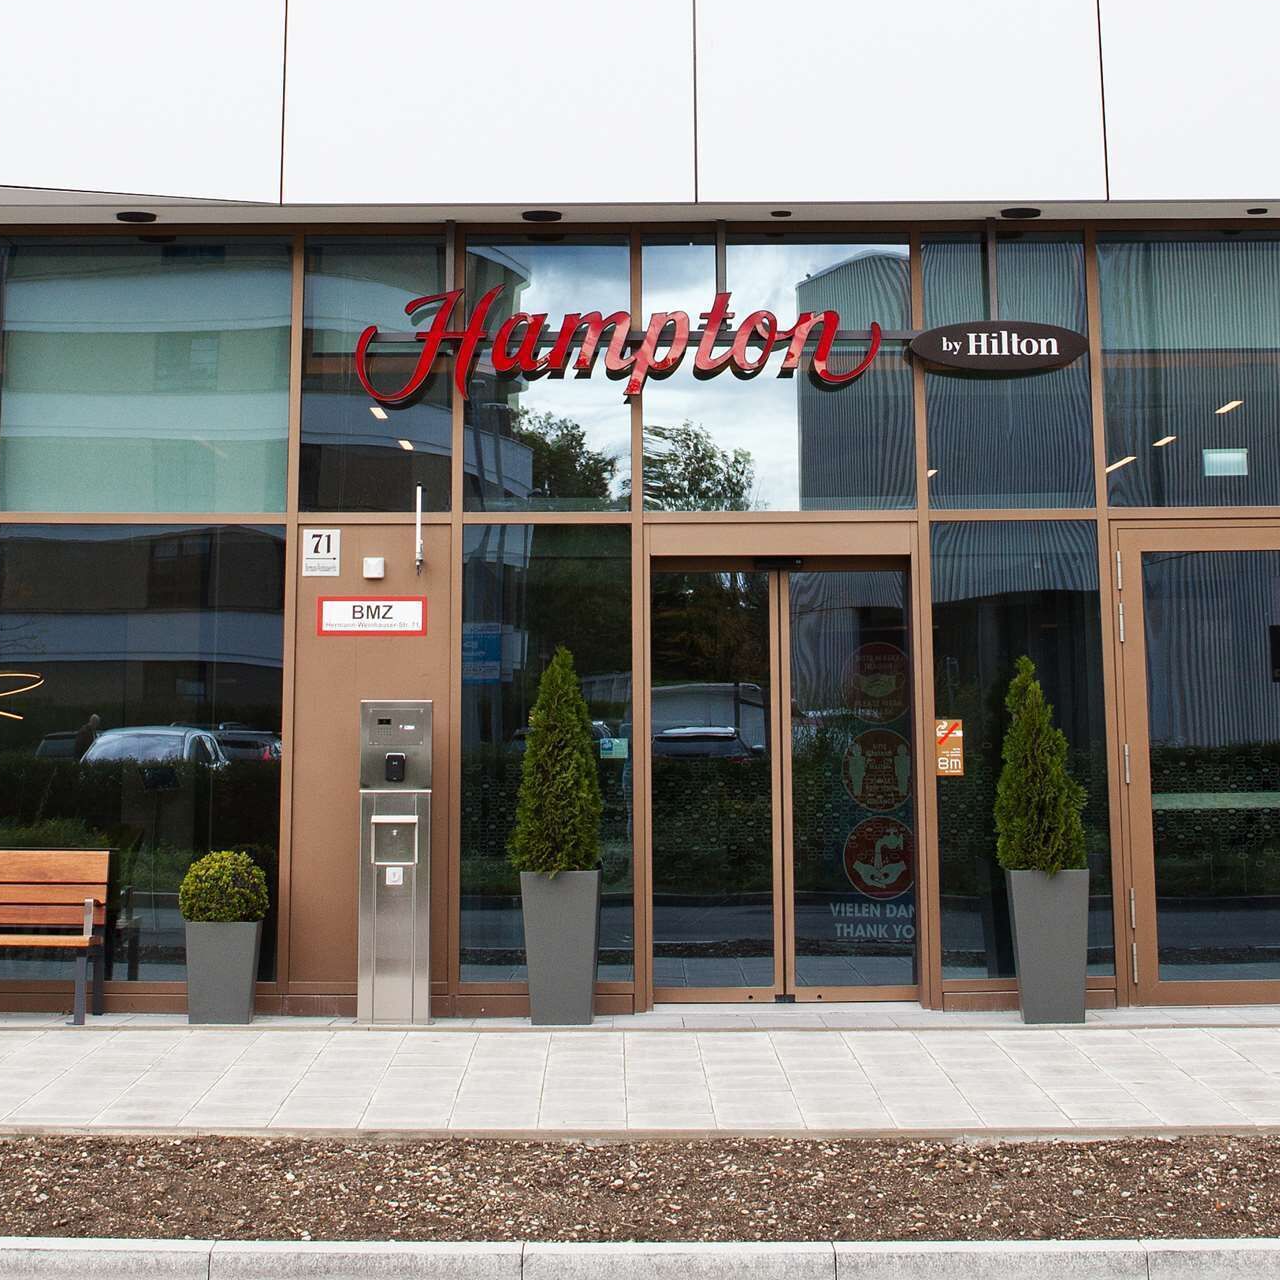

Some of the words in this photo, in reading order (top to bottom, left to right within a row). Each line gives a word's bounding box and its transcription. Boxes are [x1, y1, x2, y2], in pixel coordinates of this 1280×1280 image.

[356, 284, 881, 400] Hampton
[942, 336, 962, 355] by
[967, 330, 1059, 356] Hilton
[311, 533, 332, 554] 71
[352, 604, 393, 620] BMZ
[830, 903, 880, 917] VIELEN
[835, 923, 889, 938] THANK
